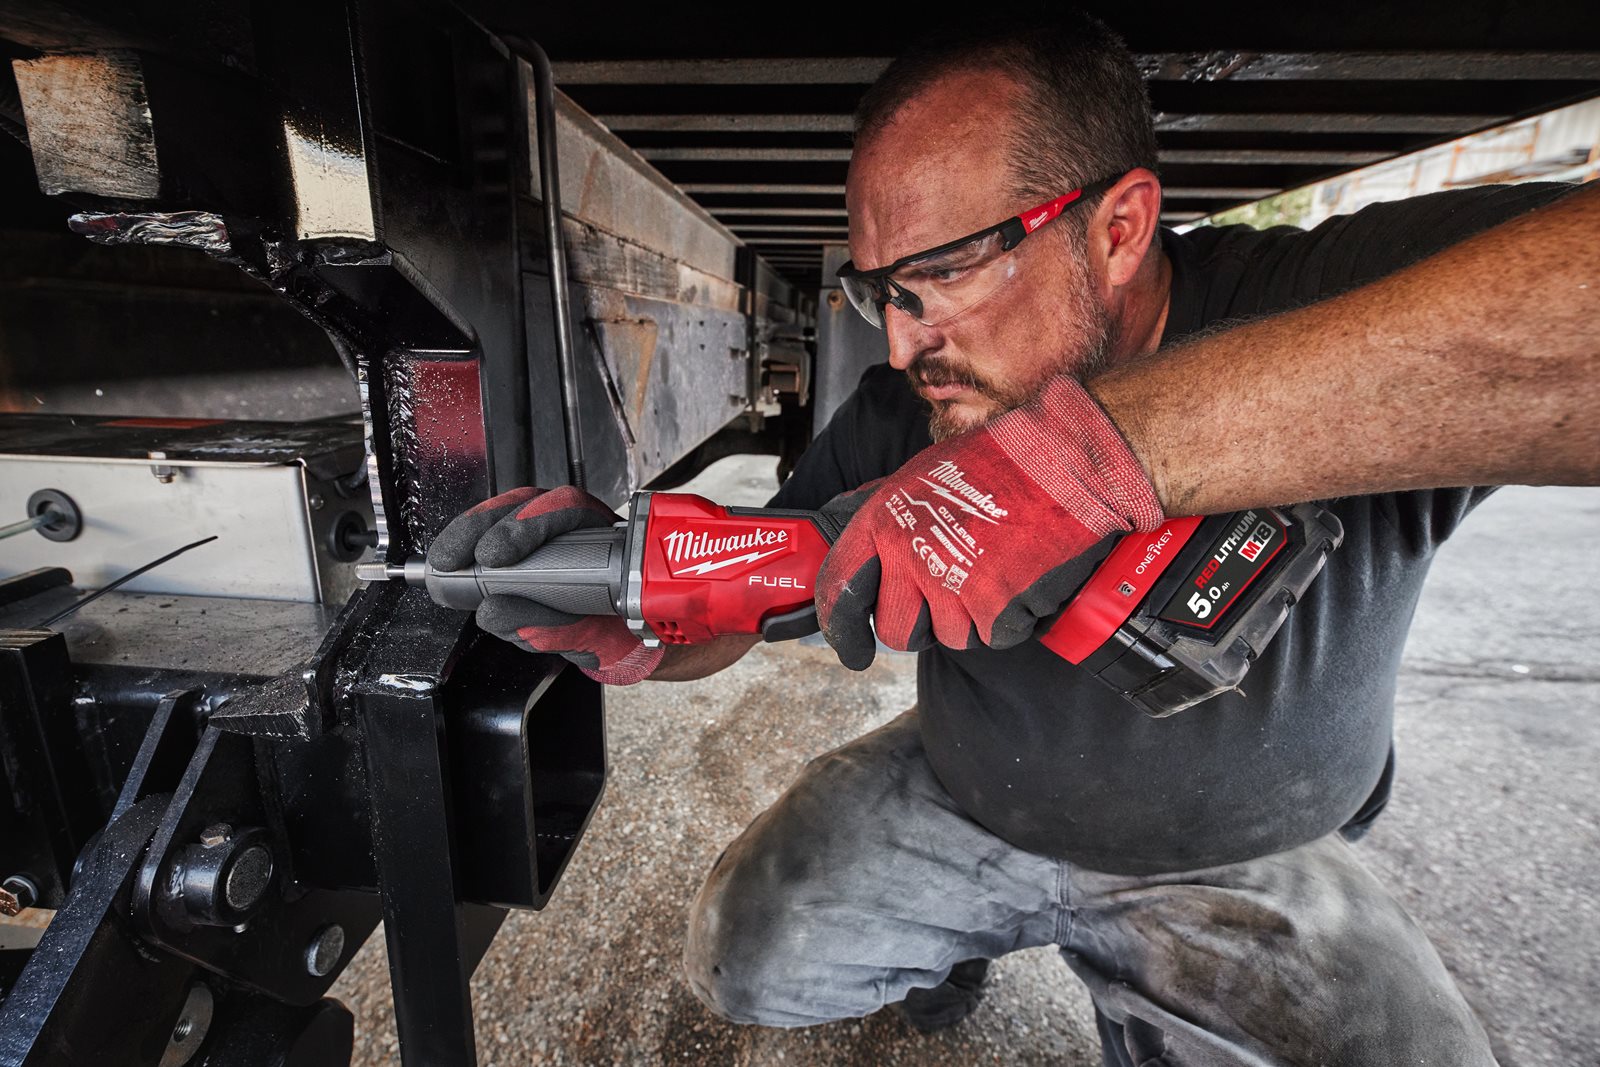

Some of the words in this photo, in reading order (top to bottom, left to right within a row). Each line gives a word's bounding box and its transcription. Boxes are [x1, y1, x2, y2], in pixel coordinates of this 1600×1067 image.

[928, 460, 1007, 518] Milwaukee
[902, 509, 917, 530] XXL
[938, 506, 955, 523] CUT
[953, 523, 977, 549] LEVEL
[663, 528, 788, 563] Milwaukee
[912, 537, 933, 560] CE
[1239, 522, 1275, 562] M18
[748, 575, 806, 589] FUEL
[1187, 586, 1221, 618] 5.0
[1221, 581, 1231, 592] Ah
